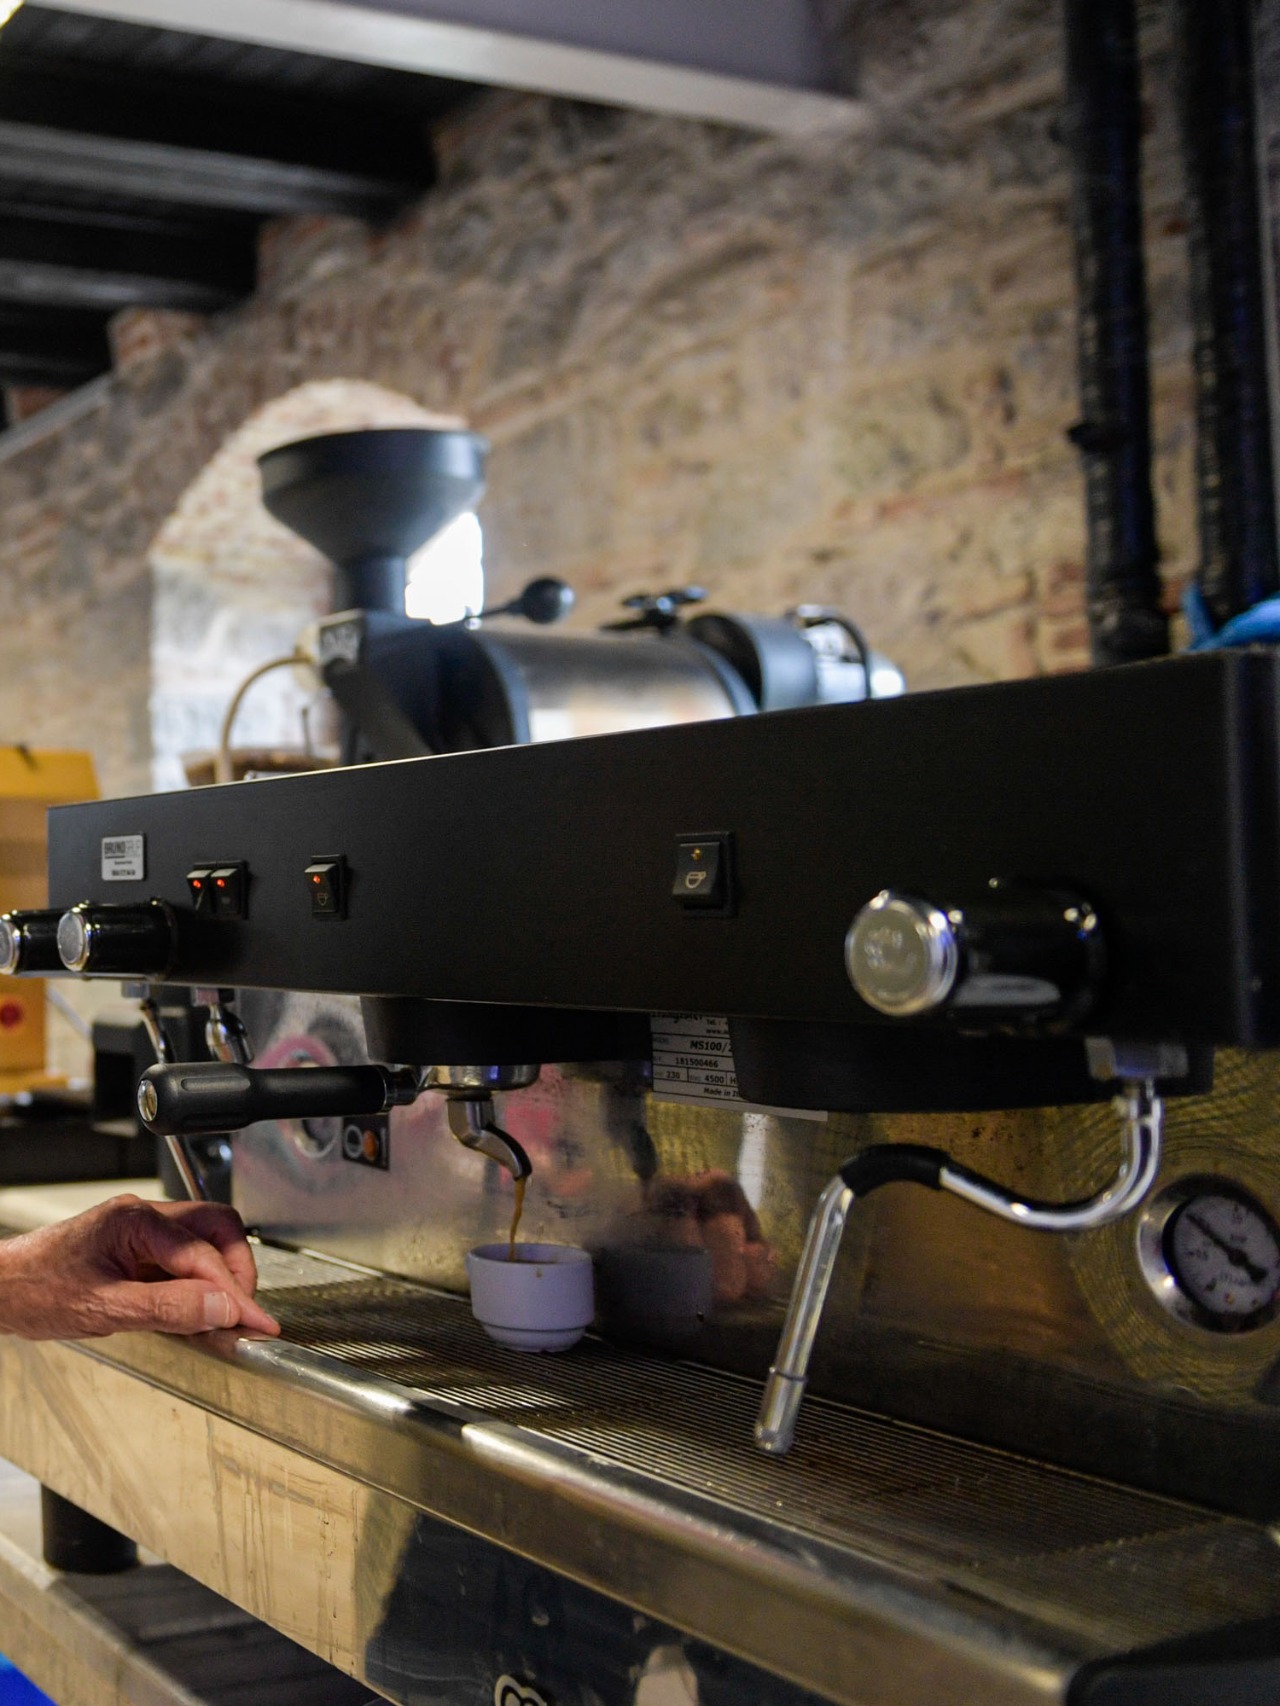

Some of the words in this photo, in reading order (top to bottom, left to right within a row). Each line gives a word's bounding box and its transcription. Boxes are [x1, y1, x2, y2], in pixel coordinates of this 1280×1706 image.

[675, 1057, 719, 1068] 181500466
[666, 1071, 680, 1079] 230
[705, 1075, 724, 1084] 4500
